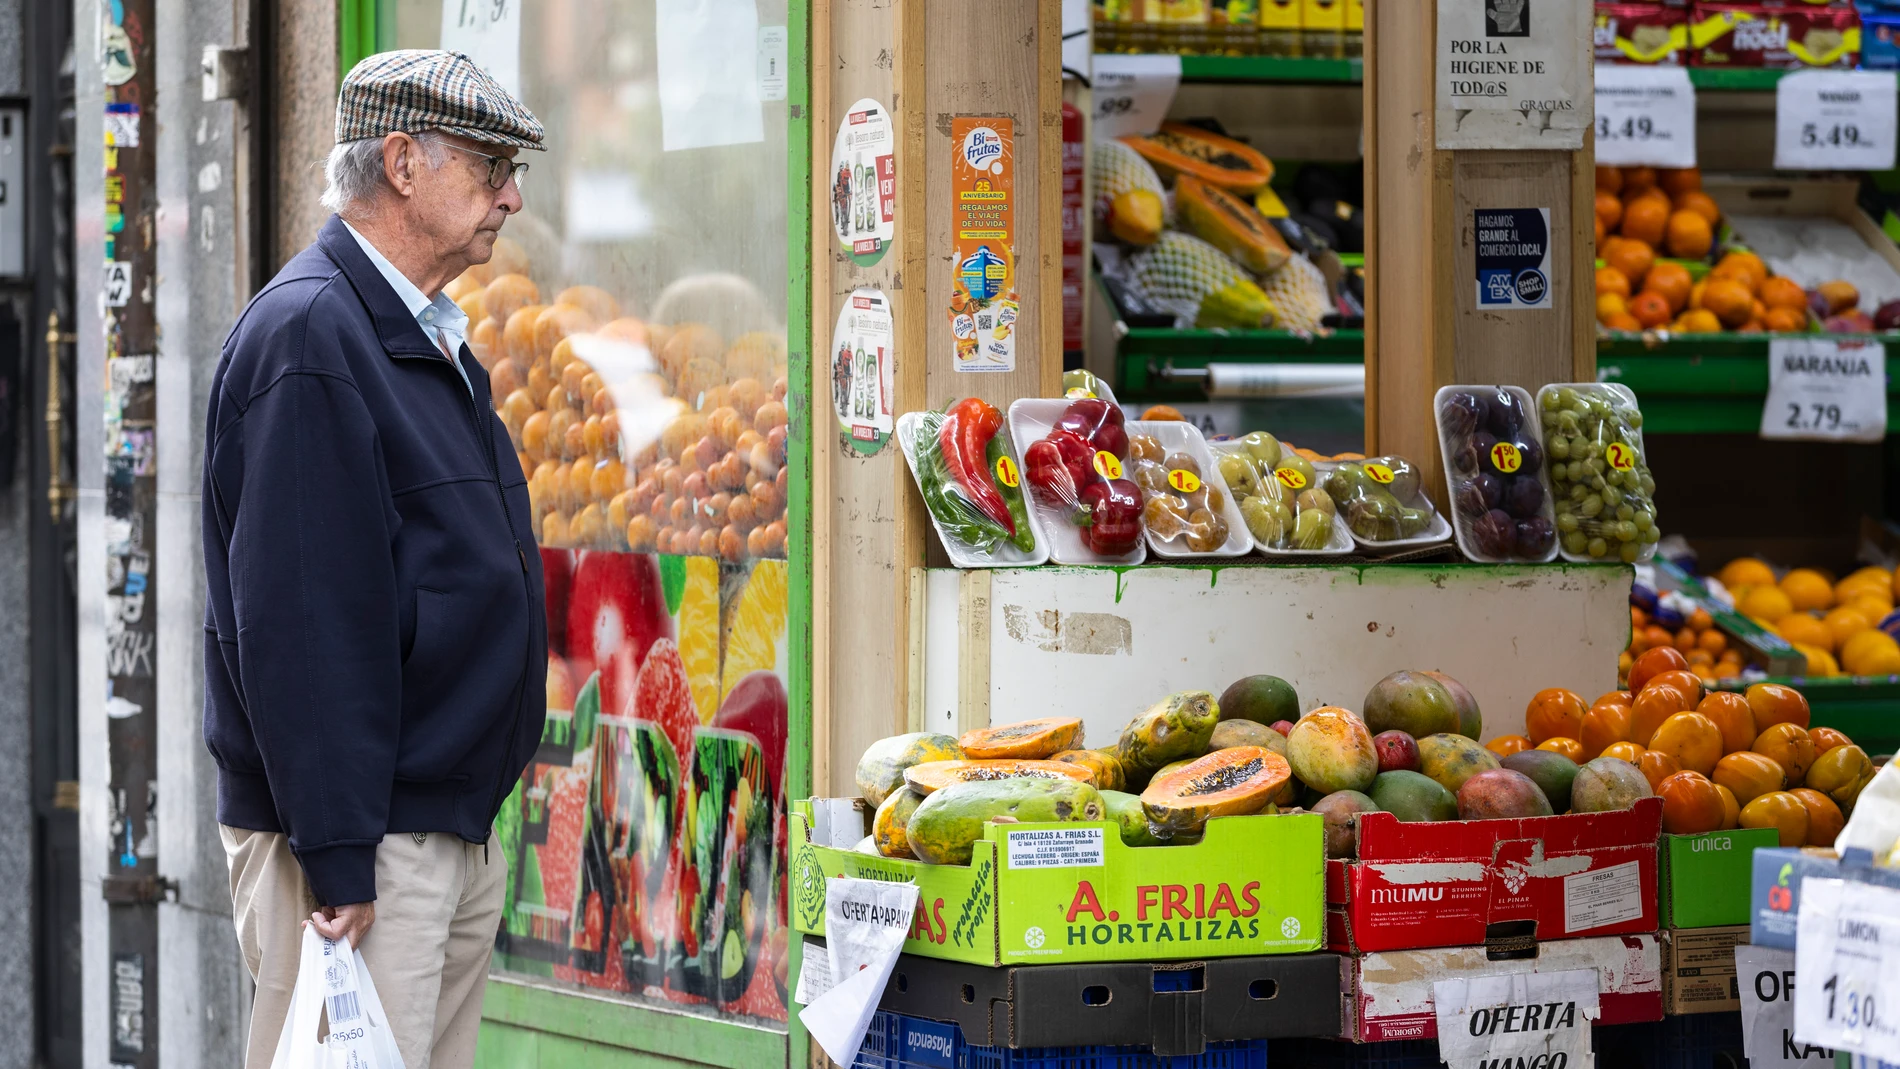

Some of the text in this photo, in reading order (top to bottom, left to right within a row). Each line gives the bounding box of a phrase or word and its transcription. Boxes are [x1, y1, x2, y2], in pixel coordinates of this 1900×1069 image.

[1451, 40, 1507, 54] POR LA
[1451, 60, 1545, 74] HIGIENE DE
[1451, 81, 1508, 98] TOD@S
[1520, 100, 1574, 111] GRACIAS.
[974, 132, 985, 146] Bi
[1802, 124, 1859, 149] 5.49
[967, 144, 1000, 160] frutas
[976, 182, 990, 191] 25
[1478, 215, 1514, 227] HAGAMOS
[1479, 230, 1520, 242] GRANDE AL
[875, 239, 881, 250] 23
[1480, 243, 1542, 256] COMERCIO LOCAL
[1519, 276, 1539, 288] SHOP
[1520, 284, 1544, 296] SMALL
[988, 345, 1008, 356] Natural
[1783, 354, 1871, 376] NARANJA
[1786, 402, 1841, 430] 2.79
[874, 429, 880, 440] 23
[1010, 832, 1054, 840] HORTALIZAS
[1592, 872, 1614, 882] FRESAS
[1066, 880, 1261, 922] A. FRIAS
[1371, 887, 1444, 904] muMU
[952, 860, 992, 948] producción
[841, 900, 879, 925] OFERTA
[966, 891, 992, 948] propia
[1067, 918, 1259, 946] HORTALIZAS
[1838, 919, 1880, 943] LIMON
[1823, 973, 1875, 1028] 1.30
[1469, 1002, 1576, 1036] OFERTA
[1384, 1027, 1422, 1037] SABORUM
[908, 1031, 952, 1058] Plasencia
